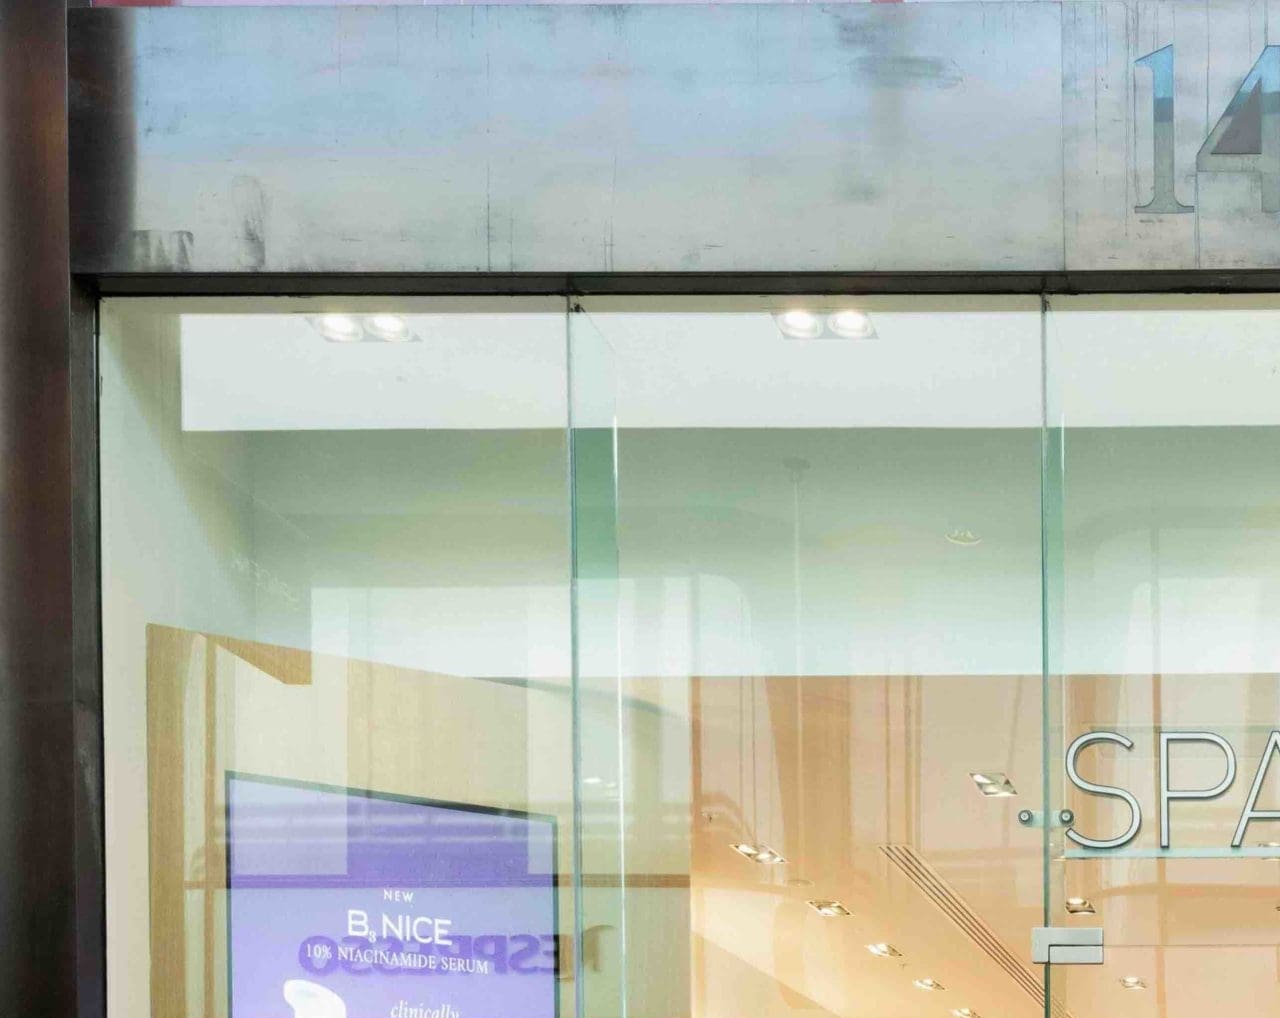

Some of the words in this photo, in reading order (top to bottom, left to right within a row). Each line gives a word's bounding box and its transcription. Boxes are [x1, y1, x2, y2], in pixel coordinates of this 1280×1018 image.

[383, 889, 414, 902] NEW
[382, 913, 453, 946] NICE
[306, 943, 332, 960] 10%
[337, 947, 437, 970] NIACINAMIDE
[441, 957, 489, 975] SERUM
